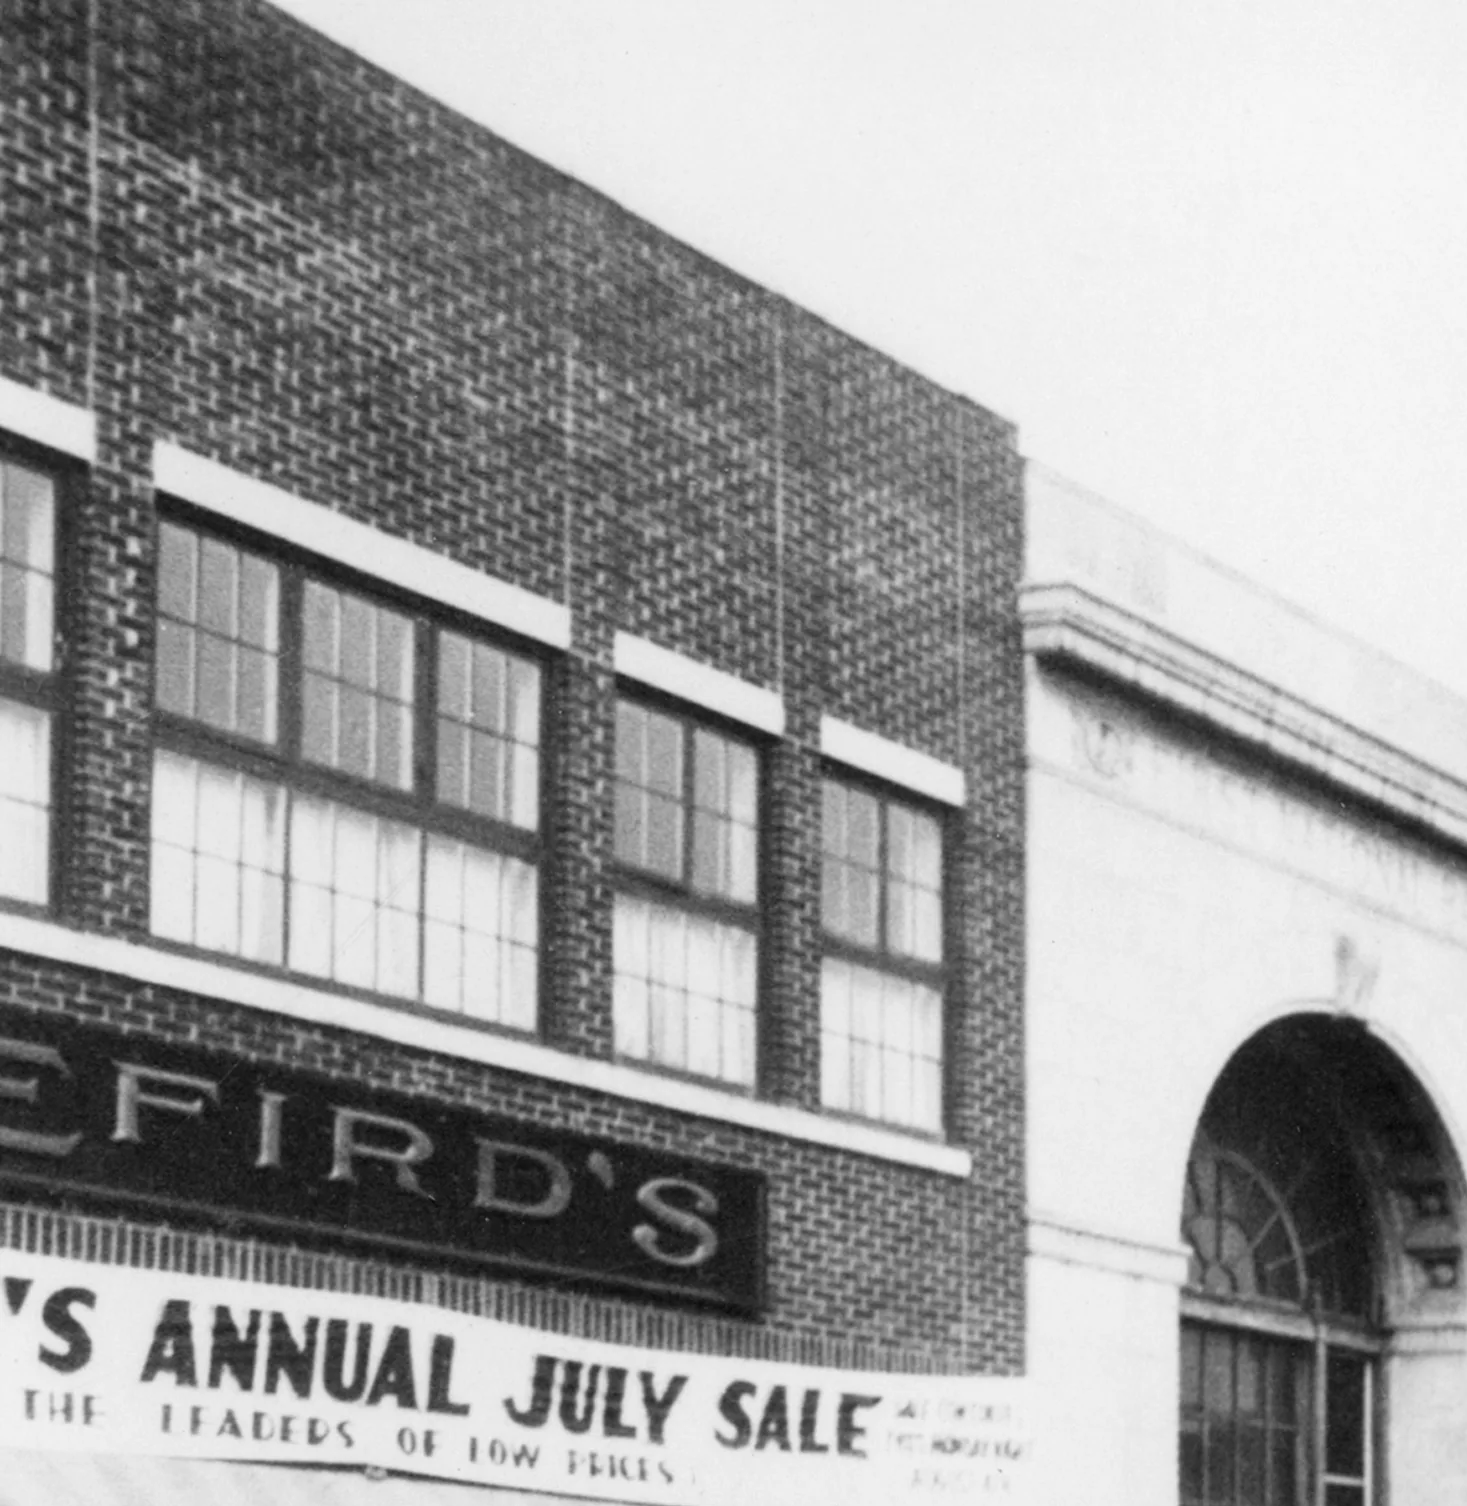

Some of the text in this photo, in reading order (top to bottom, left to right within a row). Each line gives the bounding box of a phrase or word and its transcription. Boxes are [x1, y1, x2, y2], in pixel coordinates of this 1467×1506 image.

[0, 1037, 719, 1267] EFIRD'S
[25, 1388, 674, 1485] THE LEADERS OF LOW PRICES
[140, 1300, 469, 1418] ANNUAL
[503, 1355, 688, 1445] JULY
[715, 1380, 882, 1459] SALE
